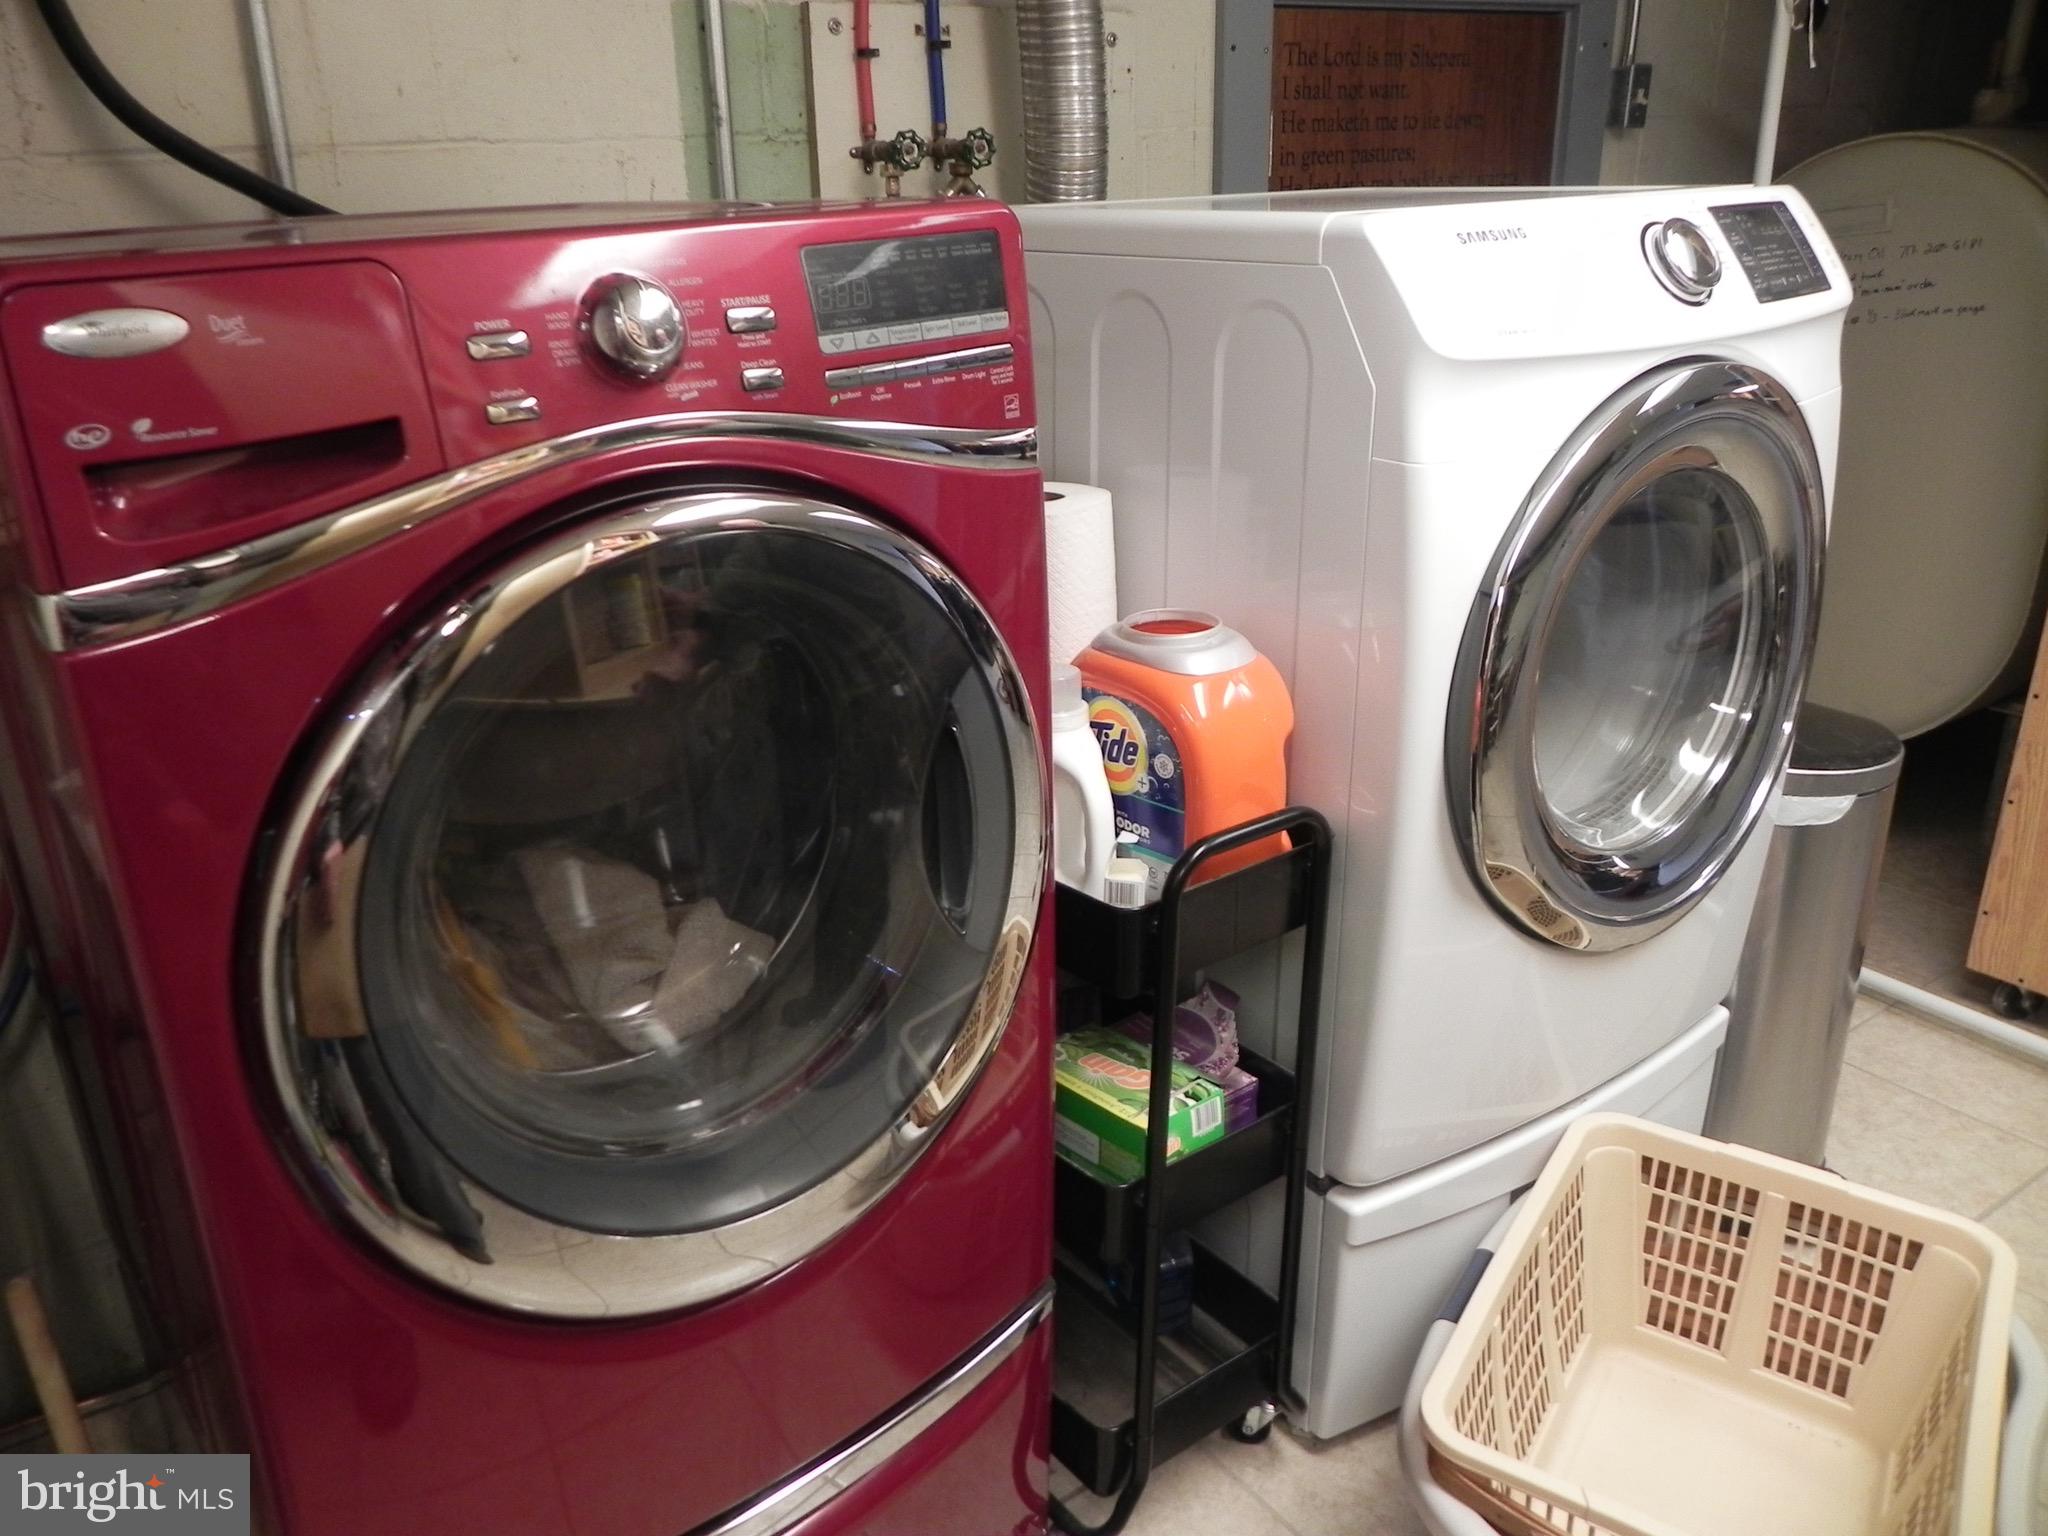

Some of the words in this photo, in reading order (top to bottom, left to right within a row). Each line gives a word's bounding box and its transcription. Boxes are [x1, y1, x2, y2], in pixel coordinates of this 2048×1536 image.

[1283, 42, 1319, 67] The
[1323, 42, 1362, 67] Lord
[1367, 44, 1379, 67] is
[1294, 74, 1332, 100] shall
[1336, 79, 1364, 100] not
[1280, 109, 1308, 133] He
[1311, 107, 1370, 133] maketh
[1375, 116, 1399, 132] me
[1403, 113, 1419, 131] to
[1279, 146, 1297, 168] in
[1301, 148, 1345, 172] green
[1456, 227, 1528, 245] SAMSUNG
[207, 314, 247, 333] Duet
[473, 318, 512, 331] POWER
[1089, 720, 1140, 767] Tide
[1115, 816, 1151, 838] ODOR
